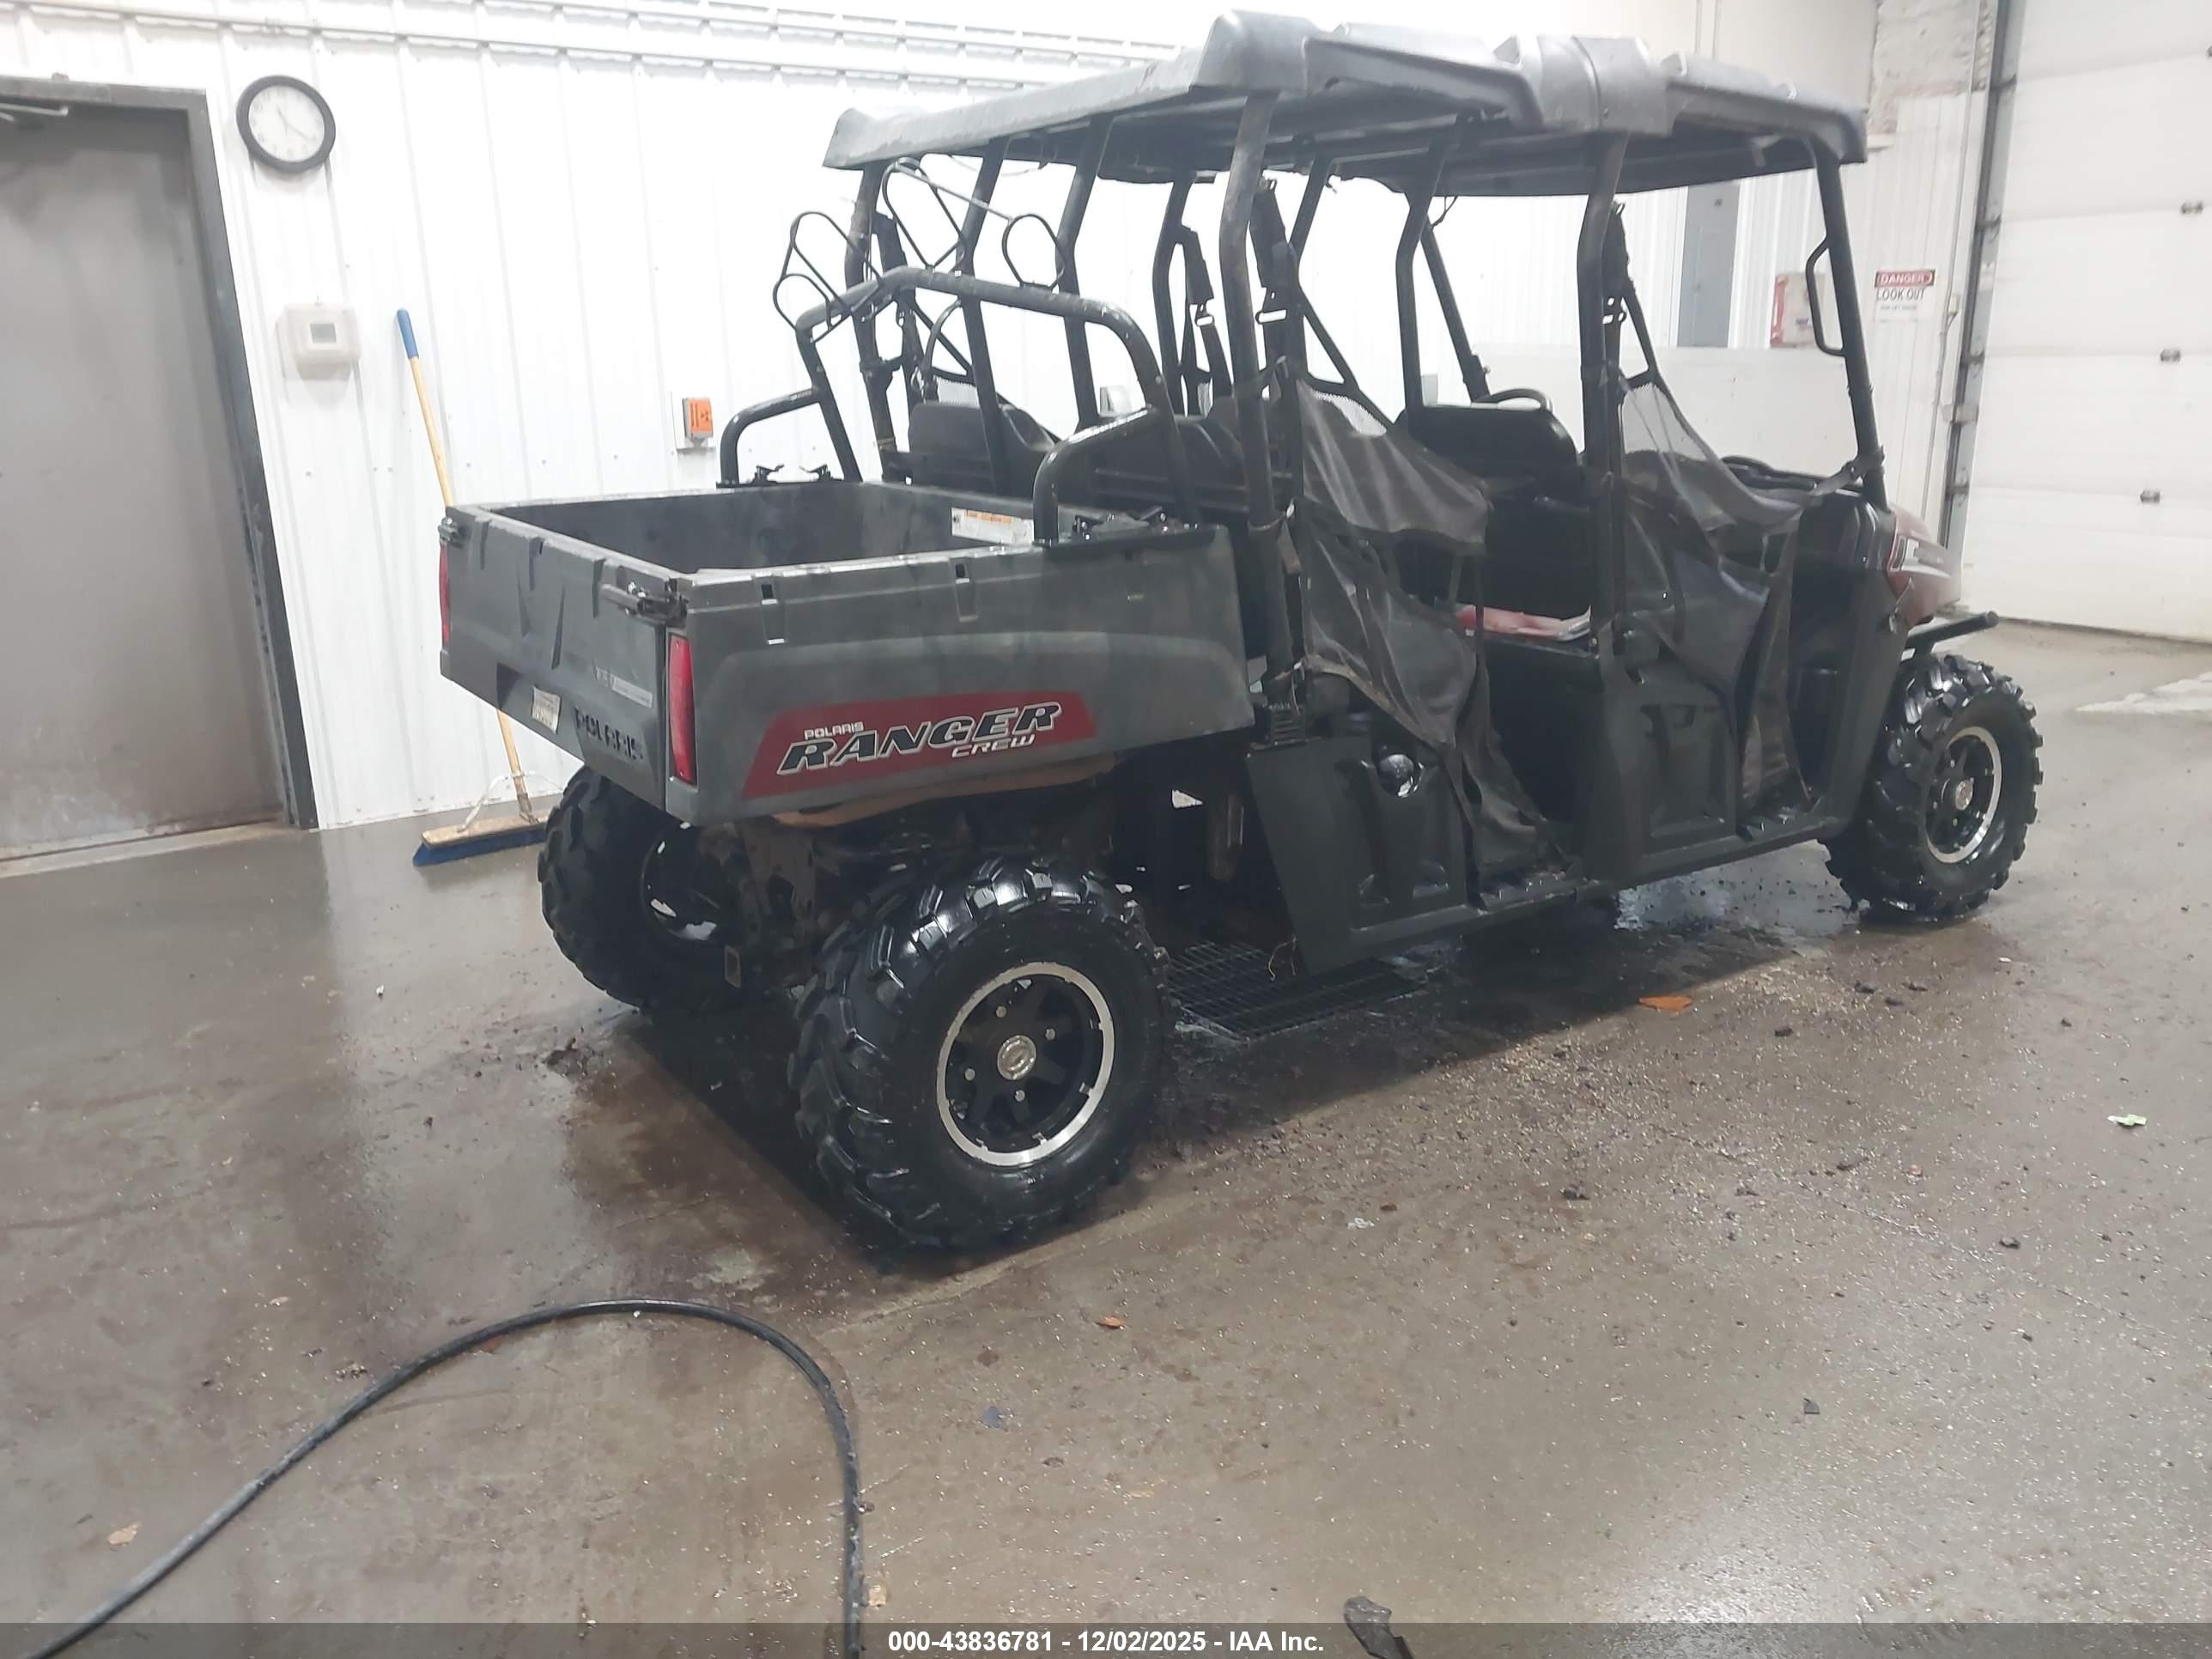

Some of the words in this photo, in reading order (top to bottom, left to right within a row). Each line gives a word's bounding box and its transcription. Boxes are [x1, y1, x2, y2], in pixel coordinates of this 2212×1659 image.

[1881, 273, 1924, 284] DANGER
[1876, 288, 1904, 301] LOOK
[1906, 287, 1924, 301] OUT
[776, 701, 1062, 775] RANGER
[804, 721, 865, 740] POLARIS
[951, 733, 1036, 758] CREW
